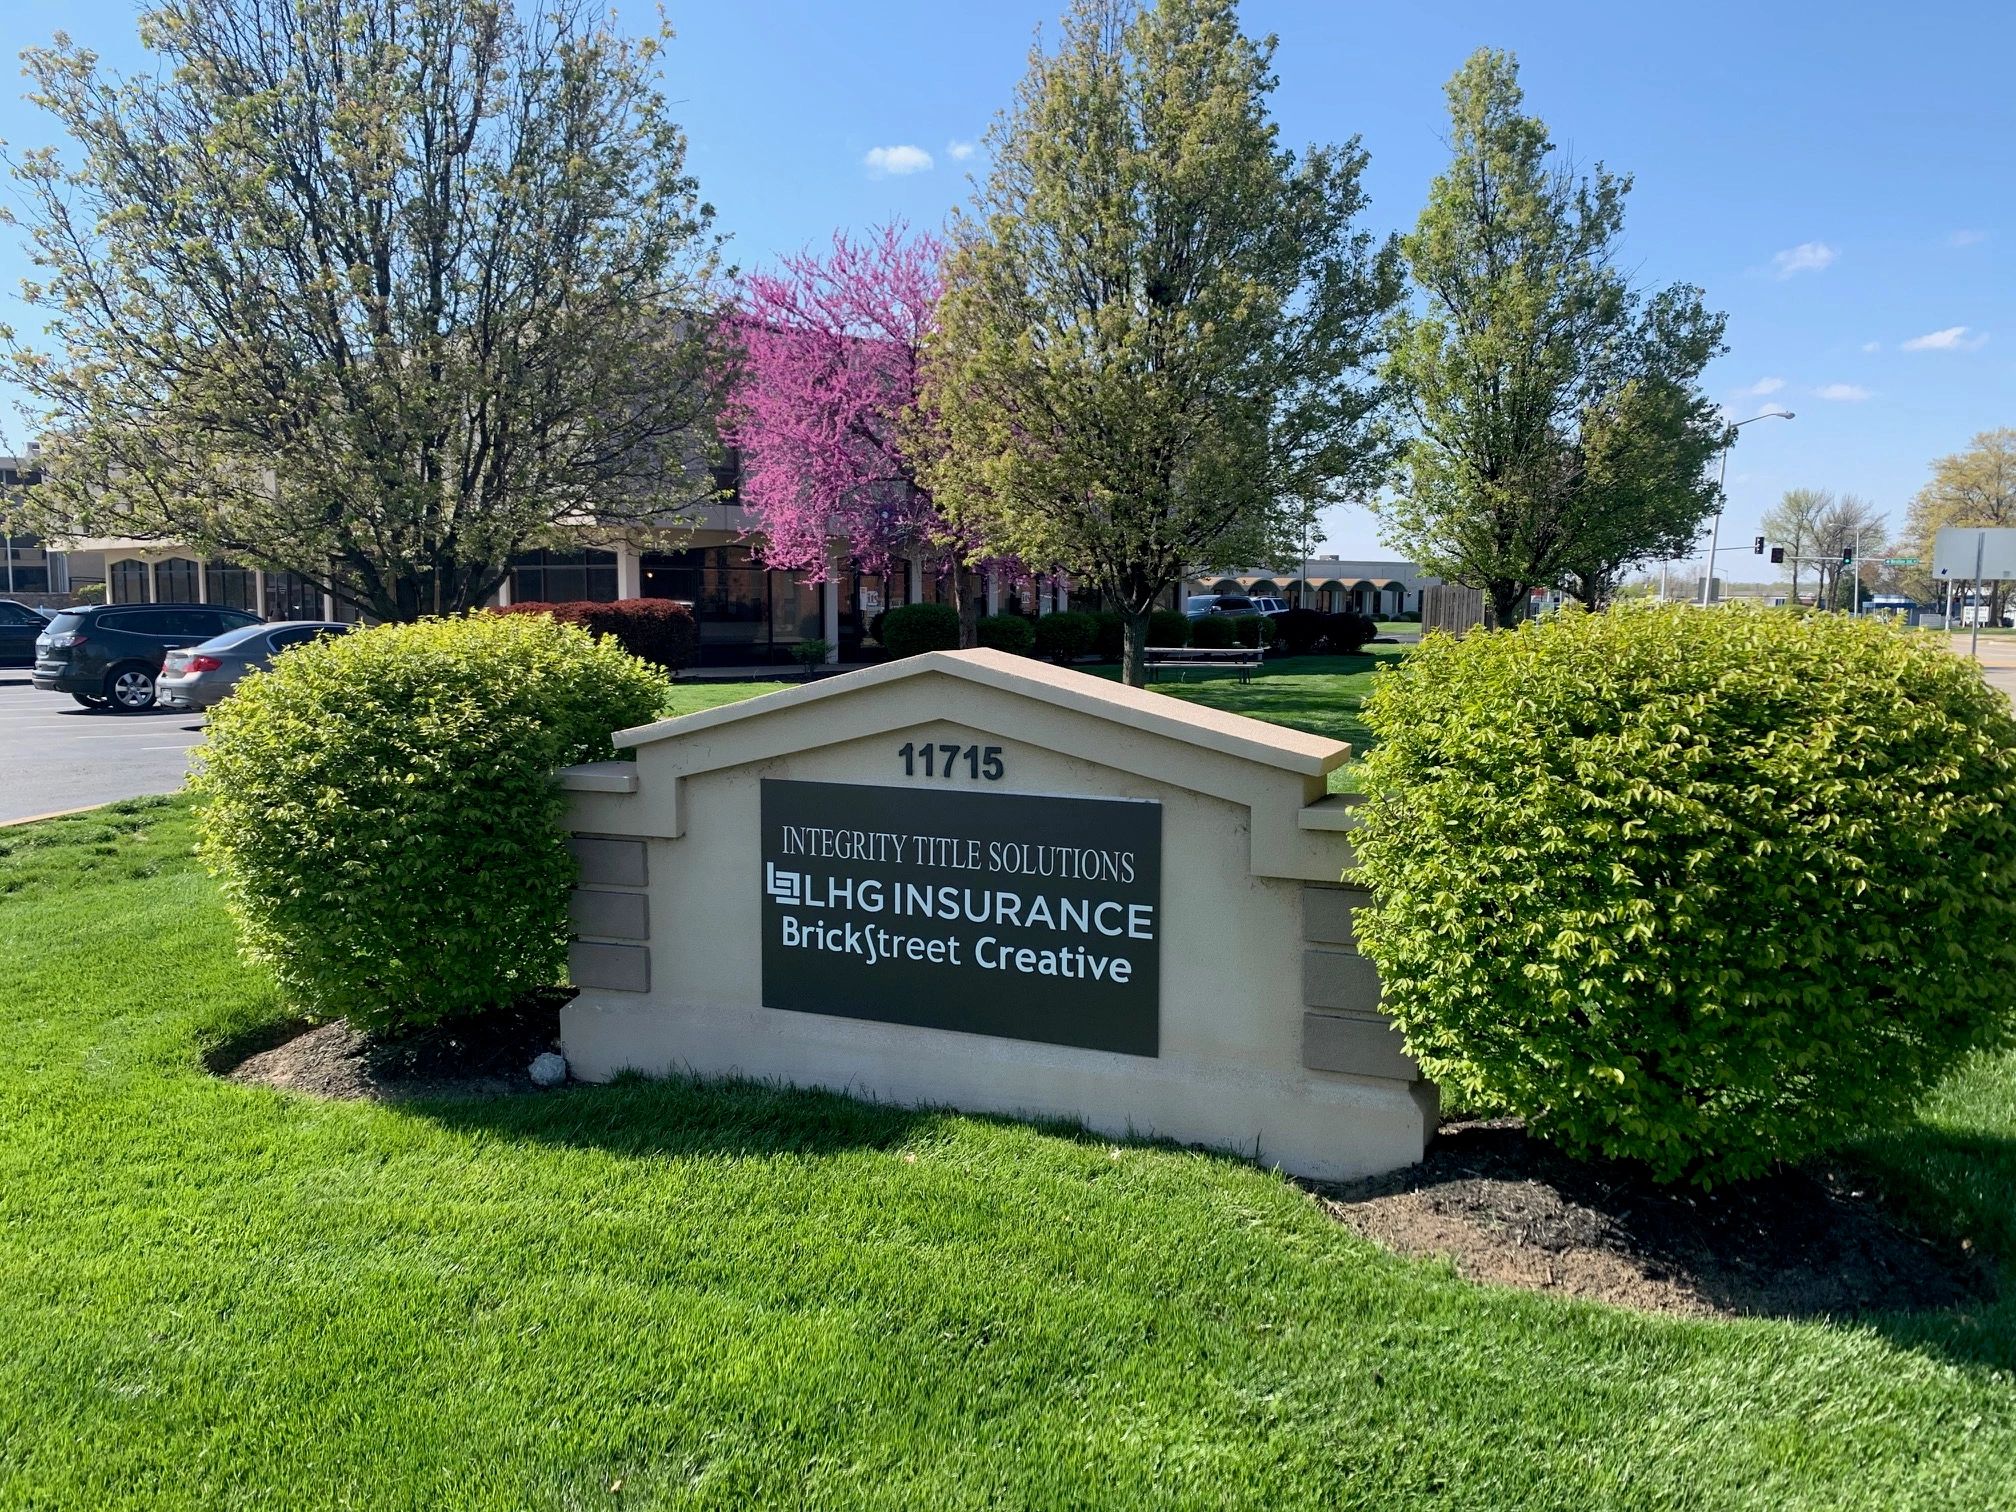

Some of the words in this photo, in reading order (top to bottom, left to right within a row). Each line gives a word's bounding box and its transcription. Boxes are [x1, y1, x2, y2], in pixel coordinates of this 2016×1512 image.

[898, 742, 1004, 780] 11715
[782, 825, 908, 864] INTEGRITY
[912, 836, 981, 870] TITLE
[988, 842, 1135, 883] SOLUTIONS
[805, 875, 884, 912] LHG
[894, 882, 1154, 939] INSURANCE
[782, 916, 961, 965] BrickStreet
[975, 937, 1132, 983] Creative
